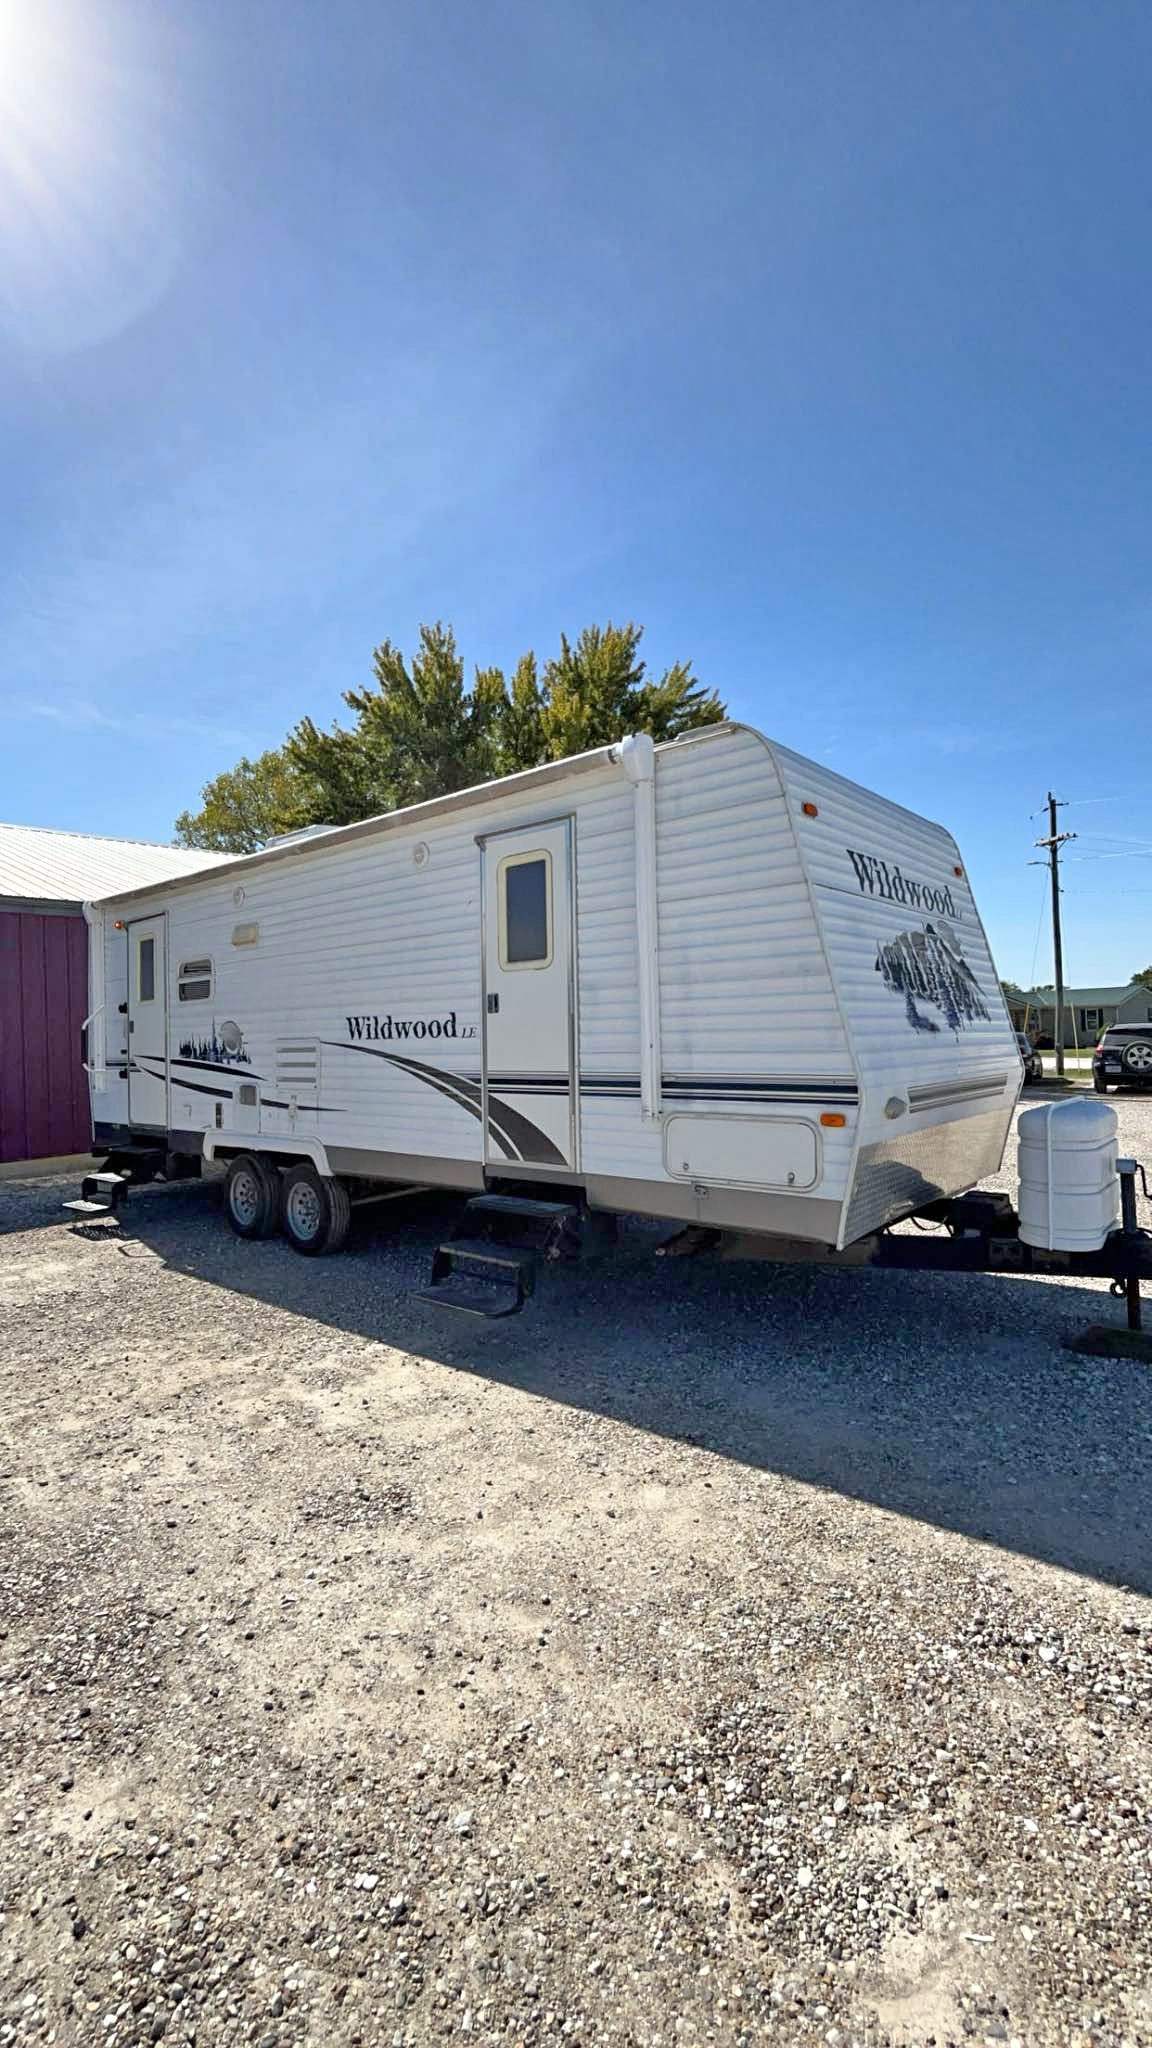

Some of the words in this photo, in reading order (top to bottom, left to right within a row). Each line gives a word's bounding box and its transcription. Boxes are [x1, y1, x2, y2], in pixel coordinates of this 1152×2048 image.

[846, 848, 956, 919] Wildwood
[346, 1011, 457, 1040] Wildwood
[461, 1026, 477, 1039] LE
